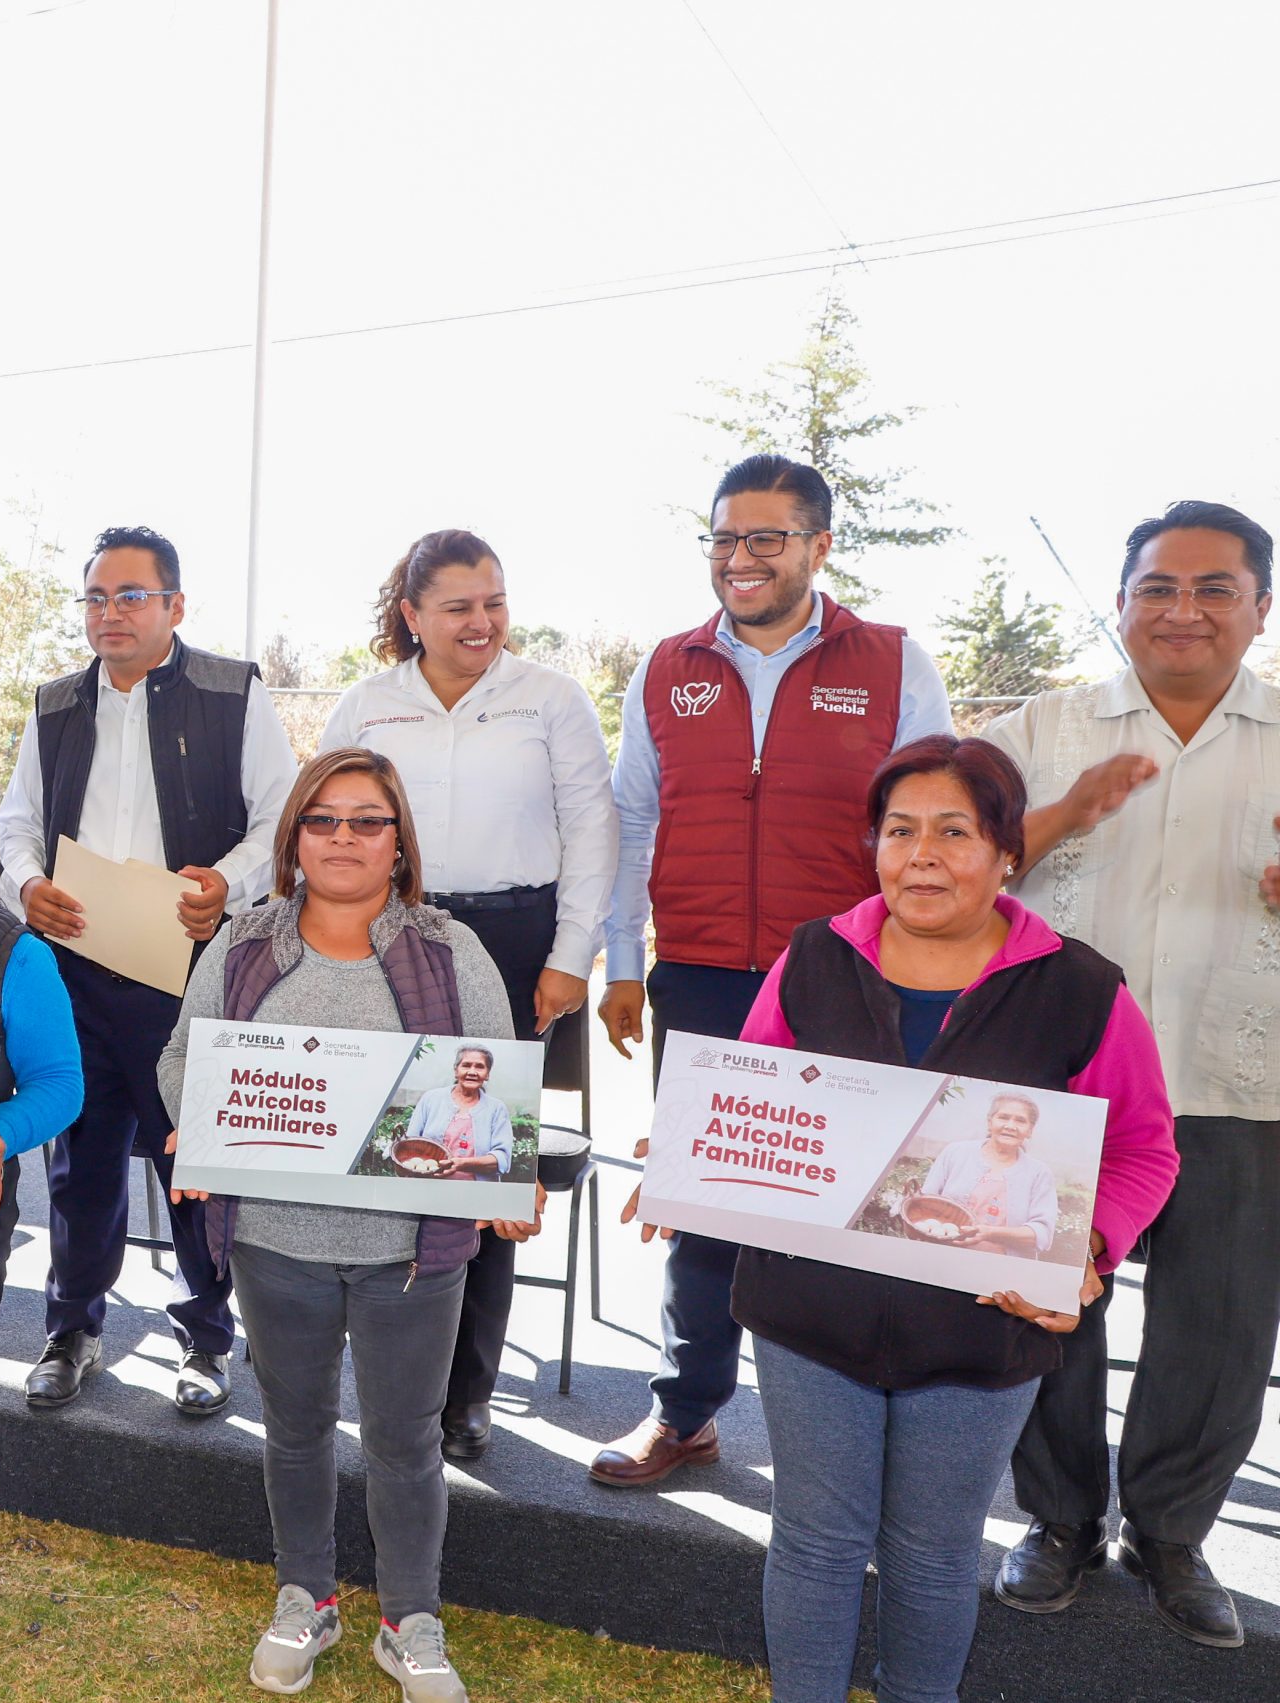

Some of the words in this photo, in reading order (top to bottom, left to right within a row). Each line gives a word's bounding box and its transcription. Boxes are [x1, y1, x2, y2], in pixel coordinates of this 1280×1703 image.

[812, 686, 868, 696] Secretaría
[825, 694, 869, 704] Bienestar
[491, 709, 539, 718] CONAGUA
[813, 702, 865, 715] Puebla
[238, 1033, 285, 1046] PUEBLA
[324, 1041, 360, 1050] Secretaría
[334, 1050, 367, 1059] Bienestar
[723, 1053, 778, 1072] PUEBLA
[231, 1068, 327, 1092] Módulos
[753, 1069, 778, 1077] presente
[826, 1072, 870, 1086] Secretaría
[824, 1081, 835, 1089] de
[837, 1082, 879, 1096] Bienestar
[227, 1090, 327, 1114] Avícolas
[711, 1092, 827, 1131] Módulos
[216, 1110, 338, 1137] Familiares
[705, 1117, 825, 1156] Avícolas
[691, 1139, 837, 1185] Familiares
